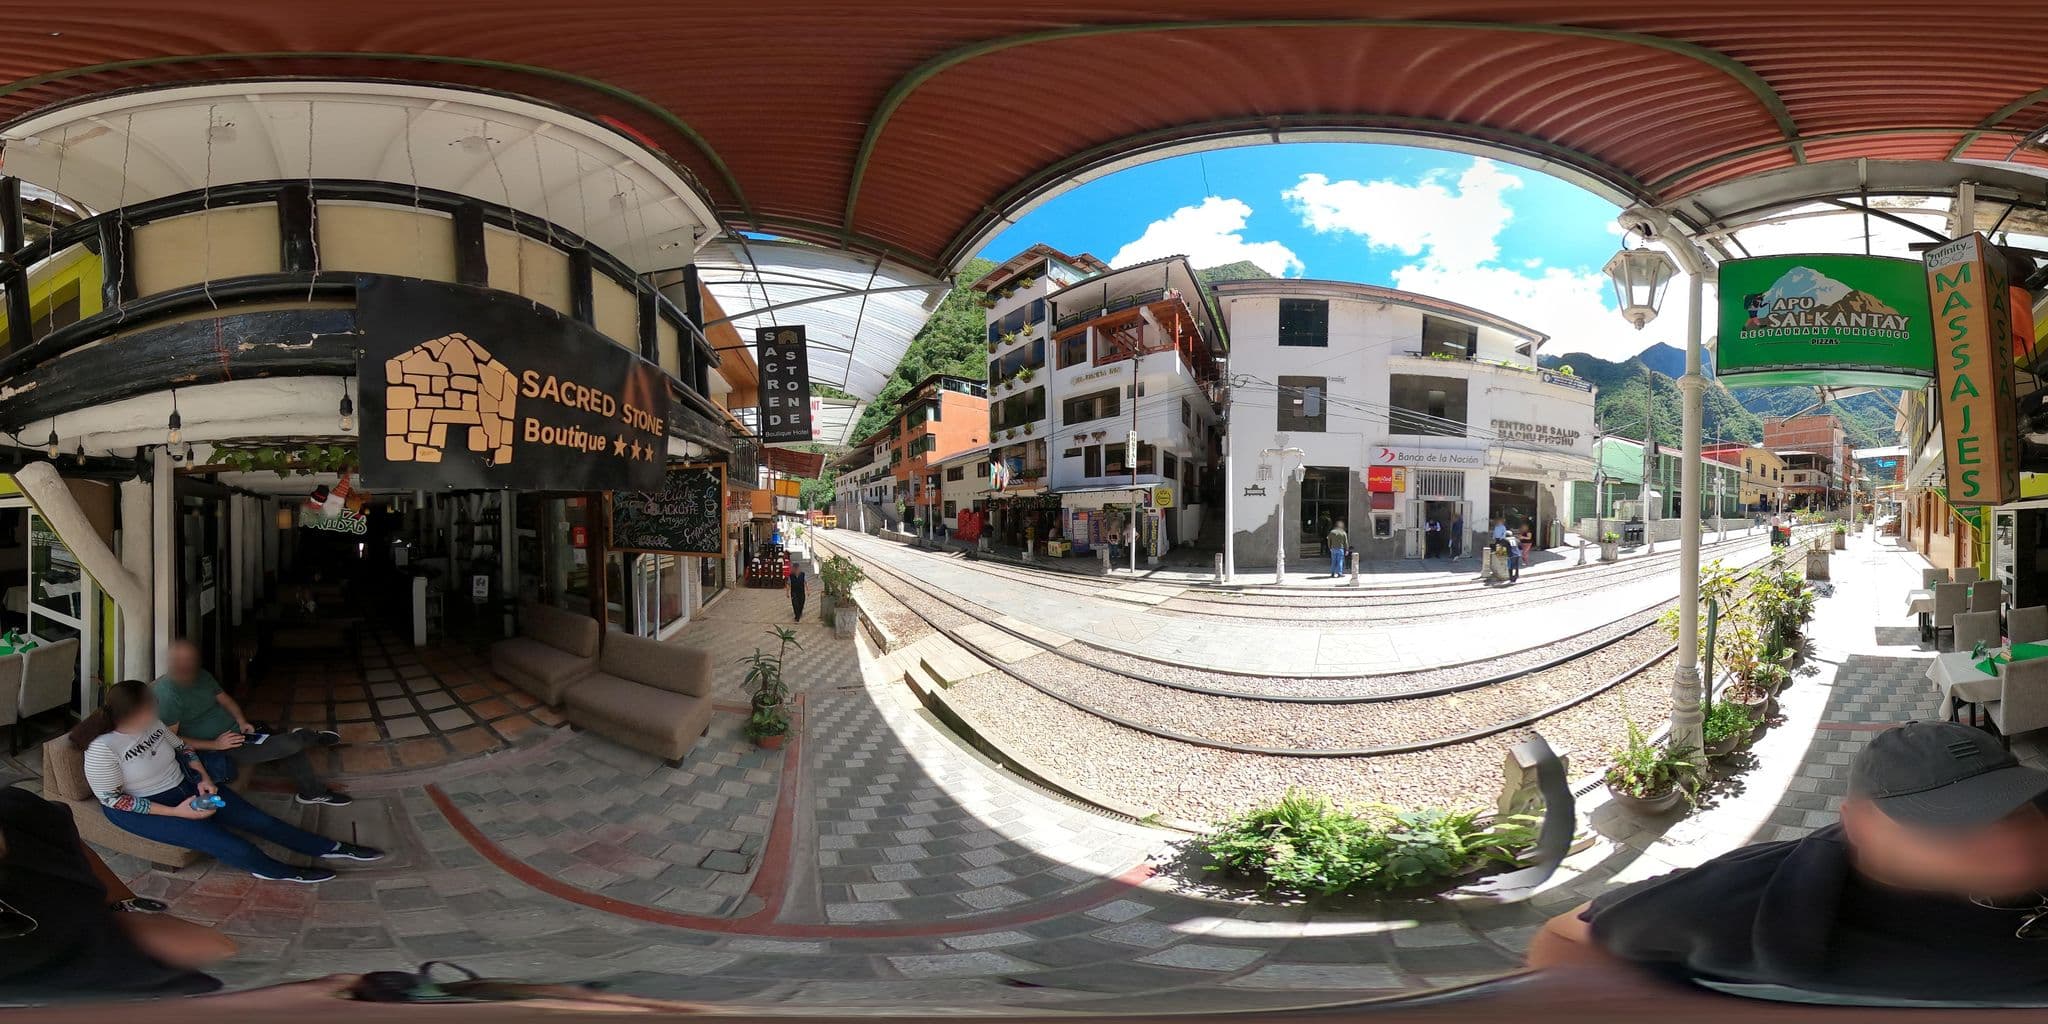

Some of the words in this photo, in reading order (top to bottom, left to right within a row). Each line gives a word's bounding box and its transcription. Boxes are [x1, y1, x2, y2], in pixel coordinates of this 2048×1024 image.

[1772, 297, 1814, 311] APU
[1768, 311, 1910, 331] SALKANTAY
[1740, 327, 1829, 339] RESTAURANT
[1835, 327, 1910, 339] TURISTICO
[764, 332, 781, 426] SACRED
[785, 351, 801, 424] STONE
[1935, 262, 1981, 498] MASSAJES
[522, 370, 616, 418] SACRED
[623, 403, 663, 437] STONE
[524, 417, 606, 453] Boutique
[1490, 419, 1533, 432] CENTRO
[1536, 424, 1548, 434] DE
[1551, 426, 1580, 439] SALUD
[1498, 430, 1536, 441] MACHU
[1398, 452, 1424, 461] Banco
[1426, 454, 1437, 462] de
[1440, 454, 1447, 462] la
[1449, 455, 1479, 463] Nación
